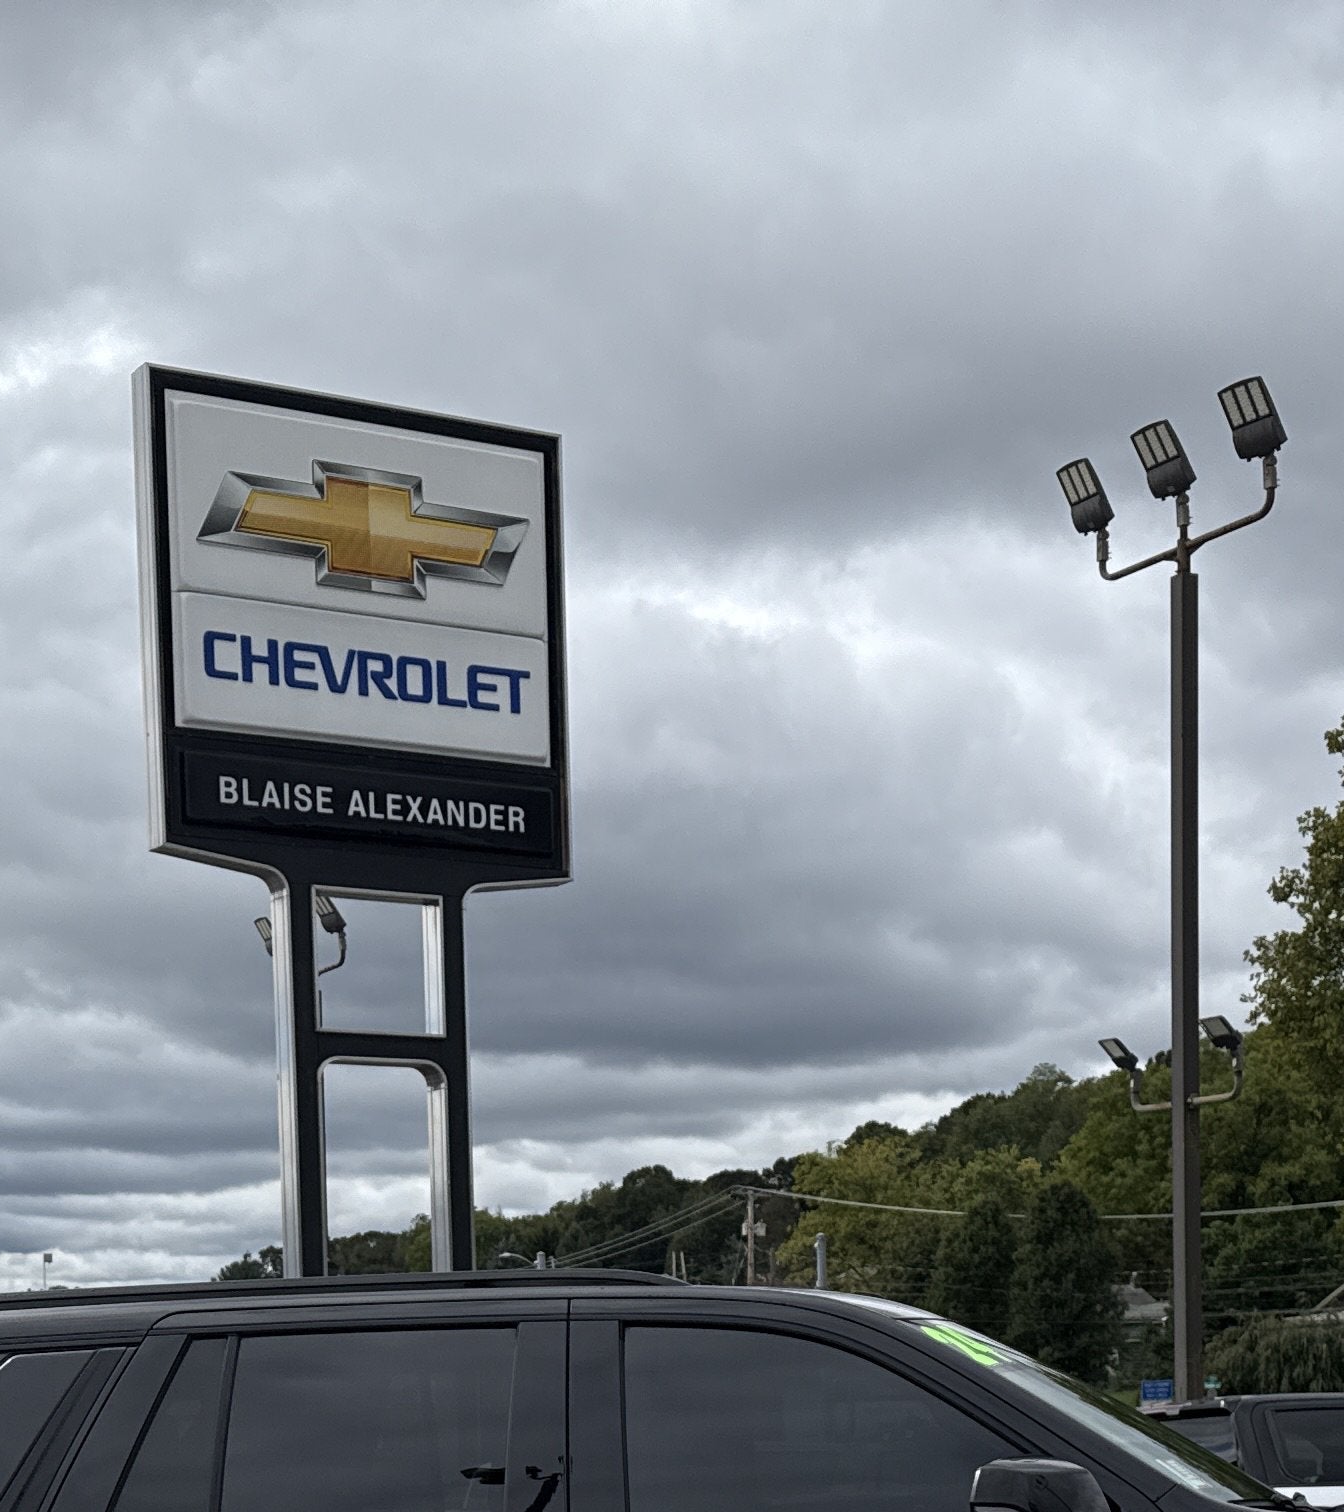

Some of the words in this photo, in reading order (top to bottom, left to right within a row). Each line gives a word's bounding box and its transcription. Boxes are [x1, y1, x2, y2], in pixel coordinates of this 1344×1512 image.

[203, 631, 531, 714] CHEVROLET
[218, 776, 334, 815] BLAISE
[347, 791, 526, 834] ALEXANDER
